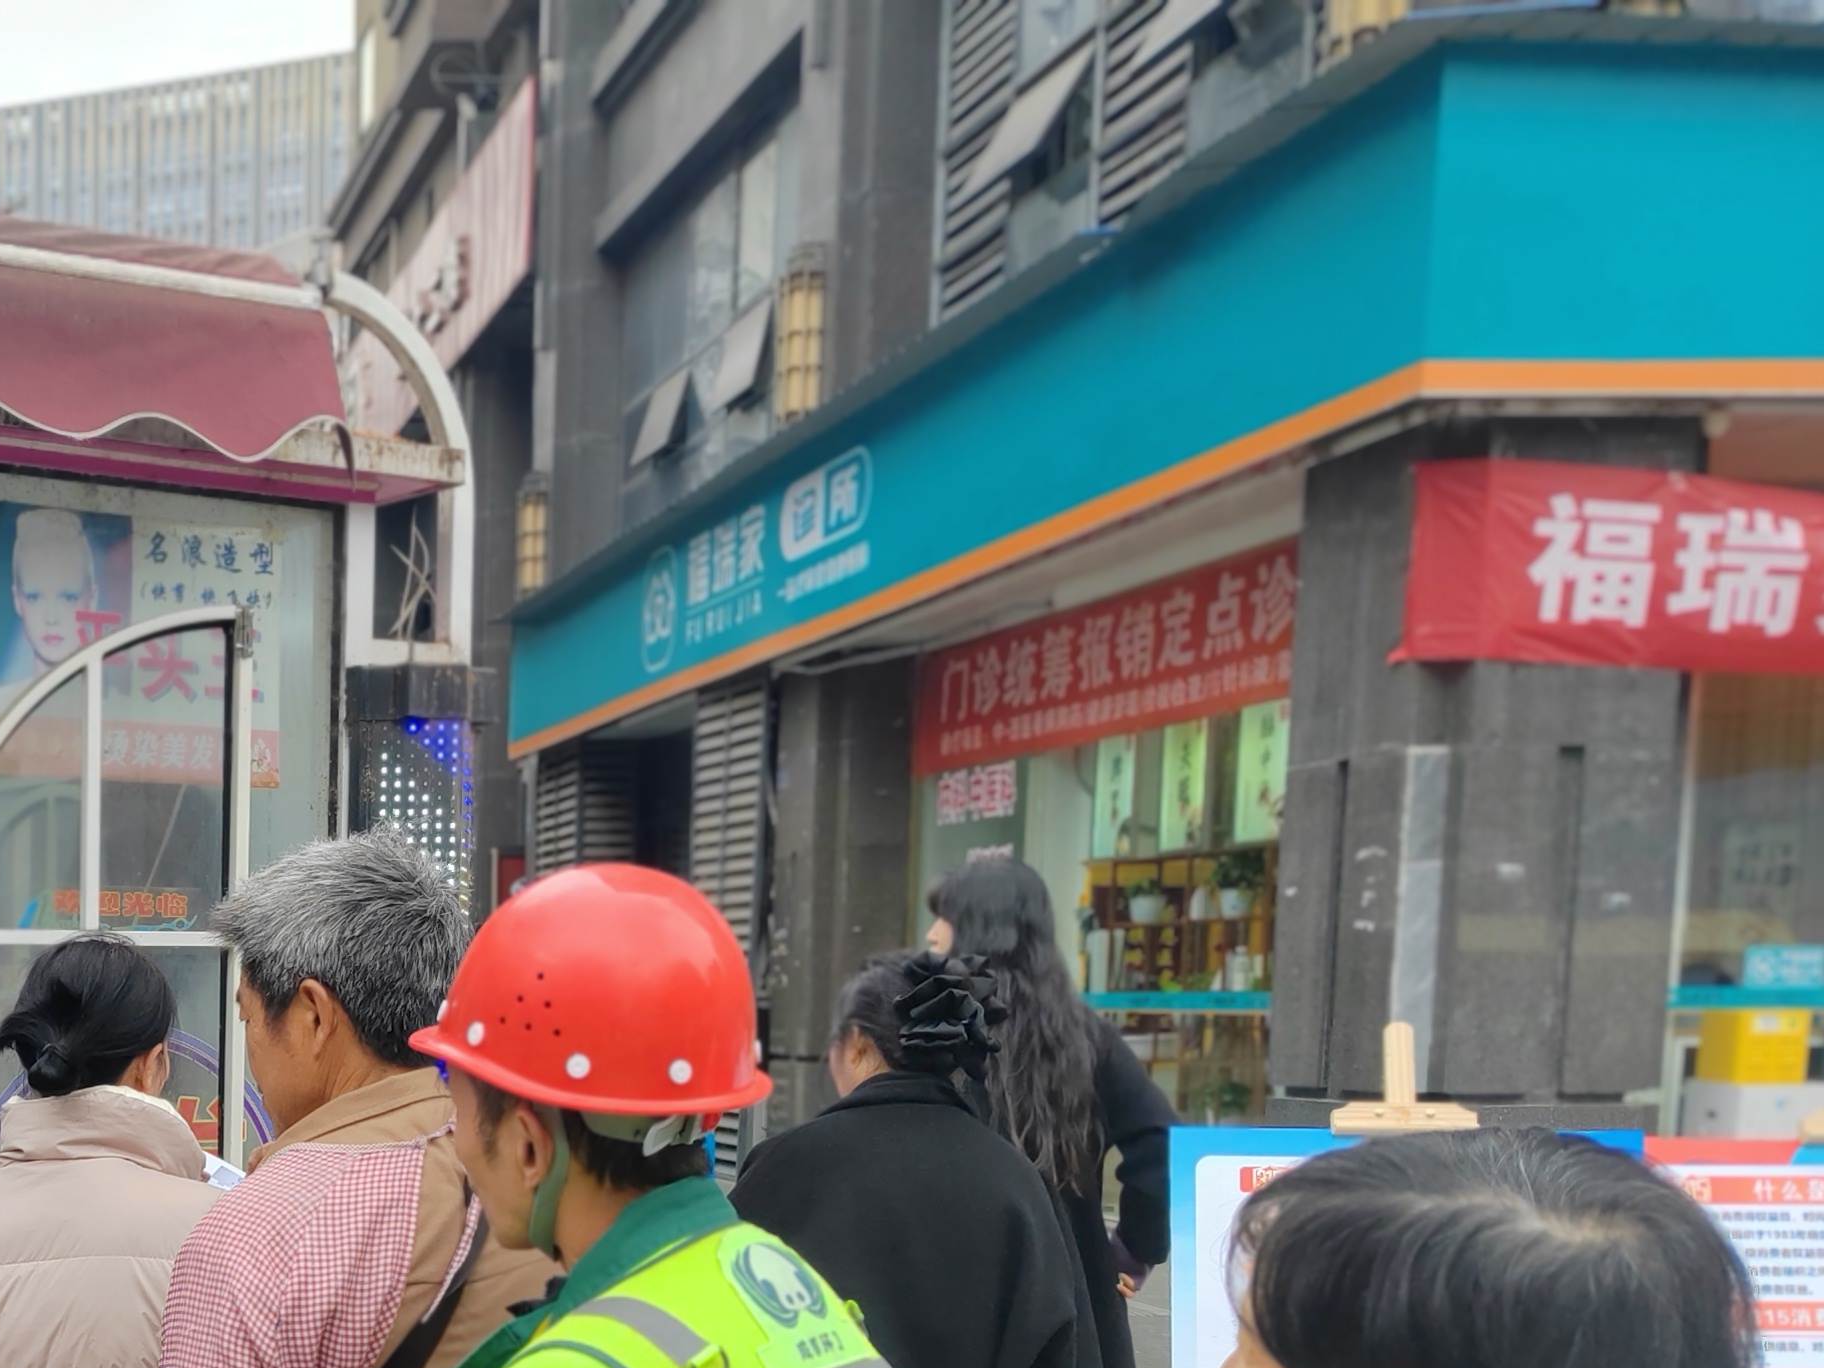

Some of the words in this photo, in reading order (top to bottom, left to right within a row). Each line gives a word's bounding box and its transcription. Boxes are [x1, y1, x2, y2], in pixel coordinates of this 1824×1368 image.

[144, 531, 274, 576] 名浪造型
[1527, 493, 1824, 637] 福瑞
